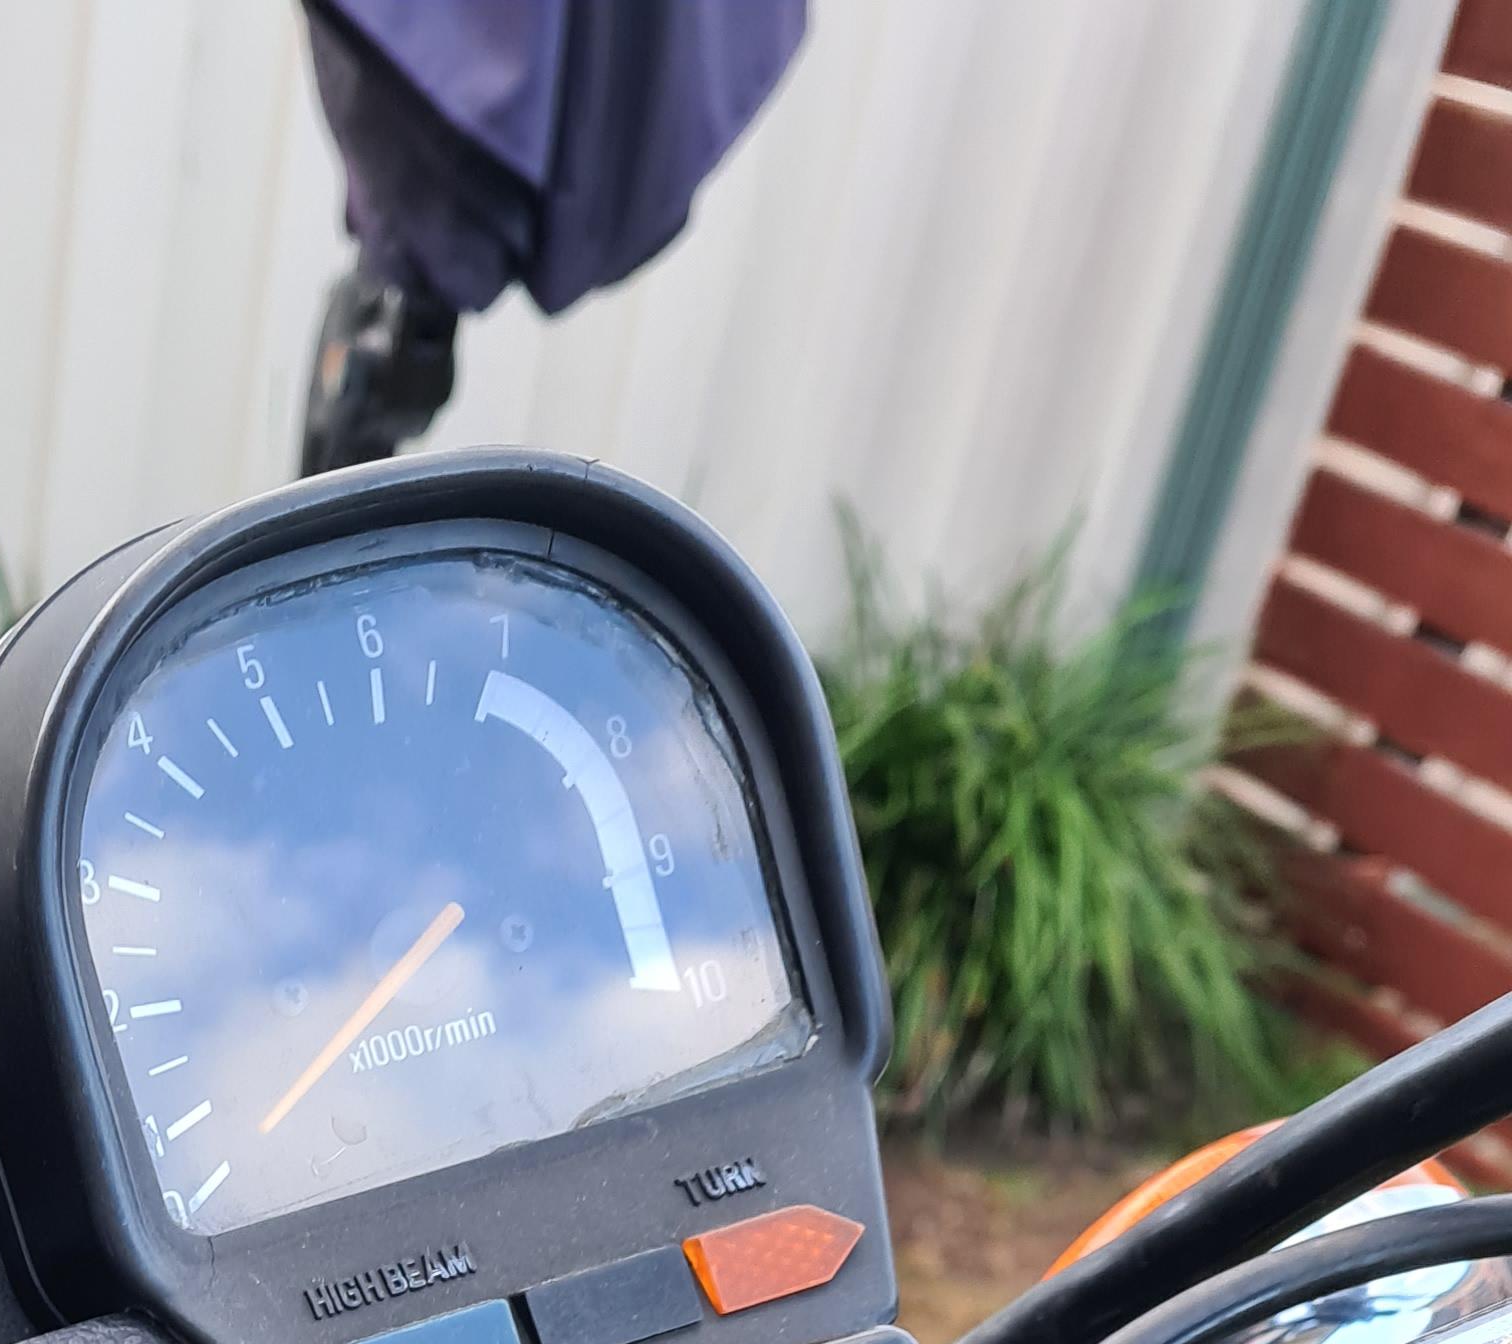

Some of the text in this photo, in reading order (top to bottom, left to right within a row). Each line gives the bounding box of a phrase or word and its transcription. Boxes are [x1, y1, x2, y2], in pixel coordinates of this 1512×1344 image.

[356, 613, 385, 659] 6
[489, 614, 511, 660] 7
[236, 644, 266, 691] 5
[126, 711, 154, 755] 4
[606, 714, 633, 760] 8
[648, 833, 676, 877] 9
[78, 859, 101, 905] 3
[683, 959, 727, 1009] 10
[101, 988, 129, 1032] 2
[674, 1157, 768, 1208] TURN
